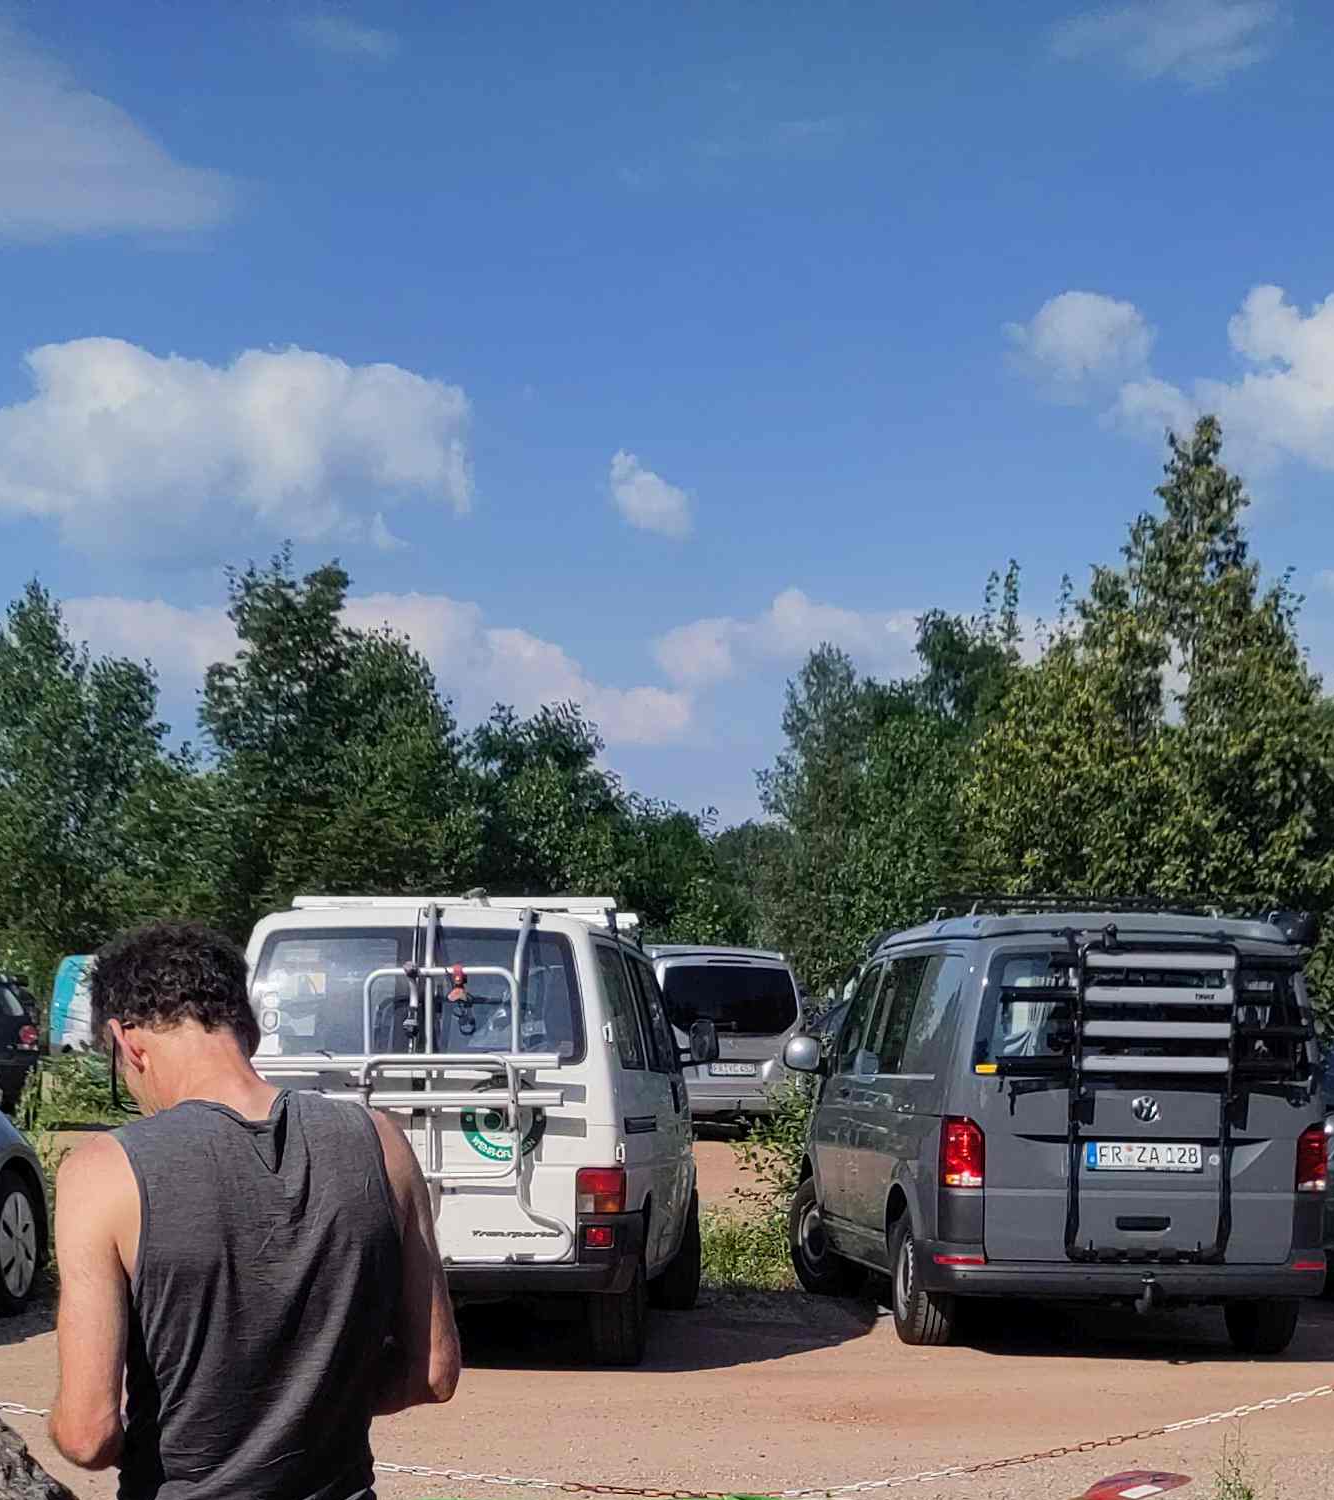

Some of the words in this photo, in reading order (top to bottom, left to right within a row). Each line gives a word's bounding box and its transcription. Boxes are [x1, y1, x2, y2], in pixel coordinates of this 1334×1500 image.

[1099, 1146, 1122, 1163] FR
[1136, 1147, 1160, 1163] ZA
[1166, 1147, 1198, 1164] 128
